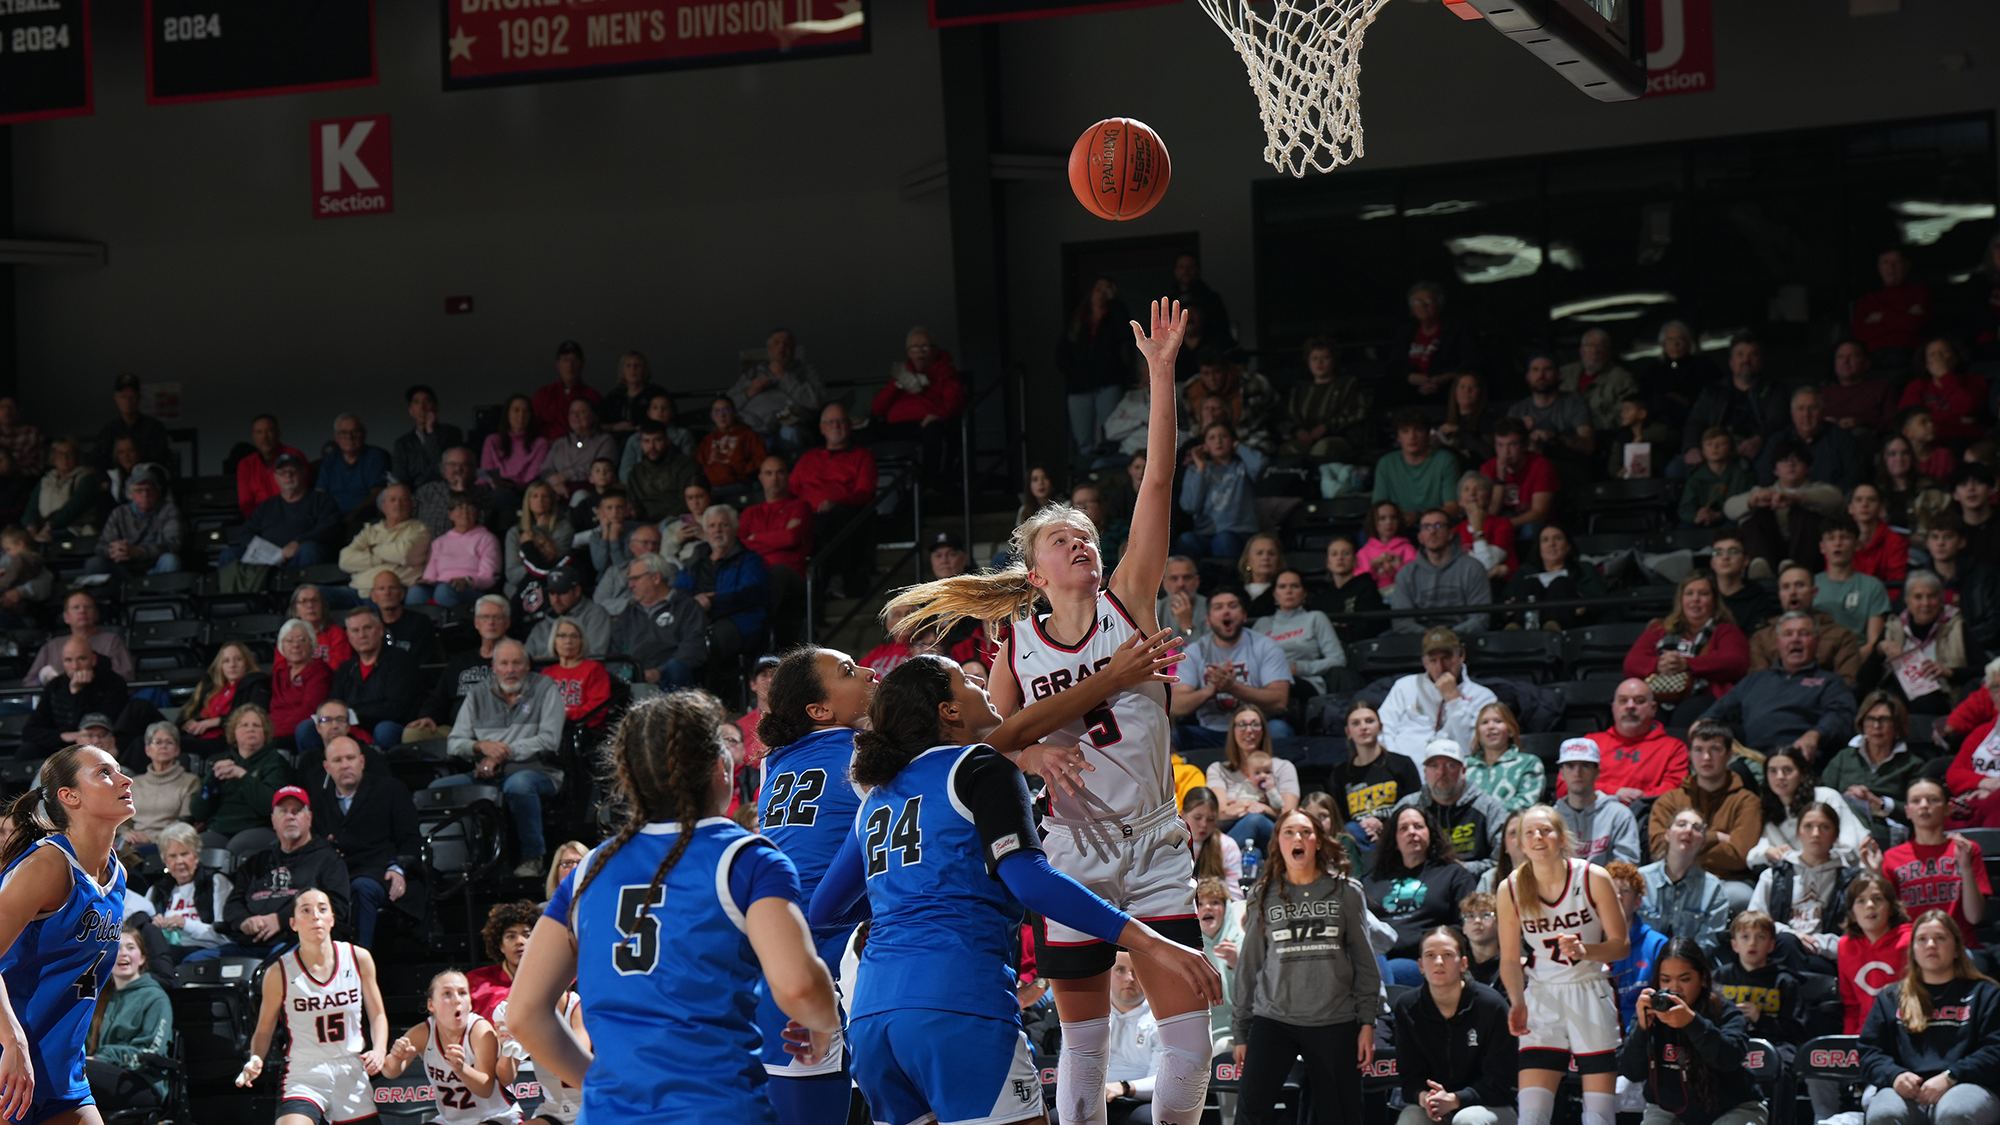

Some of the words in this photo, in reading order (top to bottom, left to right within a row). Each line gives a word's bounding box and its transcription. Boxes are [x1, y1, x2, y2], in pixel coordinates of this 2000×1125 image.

[12, 23, 70, 53] 2024
[164, 12, 221, 42] 2024
[498, 14, 570, 59] 1992
[587, 8, 666, 48] MEN'S
[677, 0, 784, 40] DIVISION
[1646, 70, 1706, 93] ection
[321, 120, 380, 192] K
[1101, 128, 1121, 194] SPALDING
[1130, 132, 1145, 192] LEGACY
[319, 193, 386, 213] Section
[1082, 700, 1122, 748] 5
[763, 768, 828, 830] 22
[1347, 780, 1398, 815] BEES
[865, 793, 924, 881] 24
[1900, 879, 1962, 908] COLLEG
[1268, 900, 1340, 923] GRACE
[1523, 908, 1593, 933] GRACE
[612, 883, 667, 977] 5
[1287, 918, 1326, 943] 172
[293, 988, 359, 1012] GRACE
[315, 1012, 346, 1044] 15
[1361, 1059, 1399, 1077] ACE
[1810, 1049, 1860, 1068] GRA
[374, 1085, 435, 1103] GRACE
[437, 1085, 477, 1110] 22
